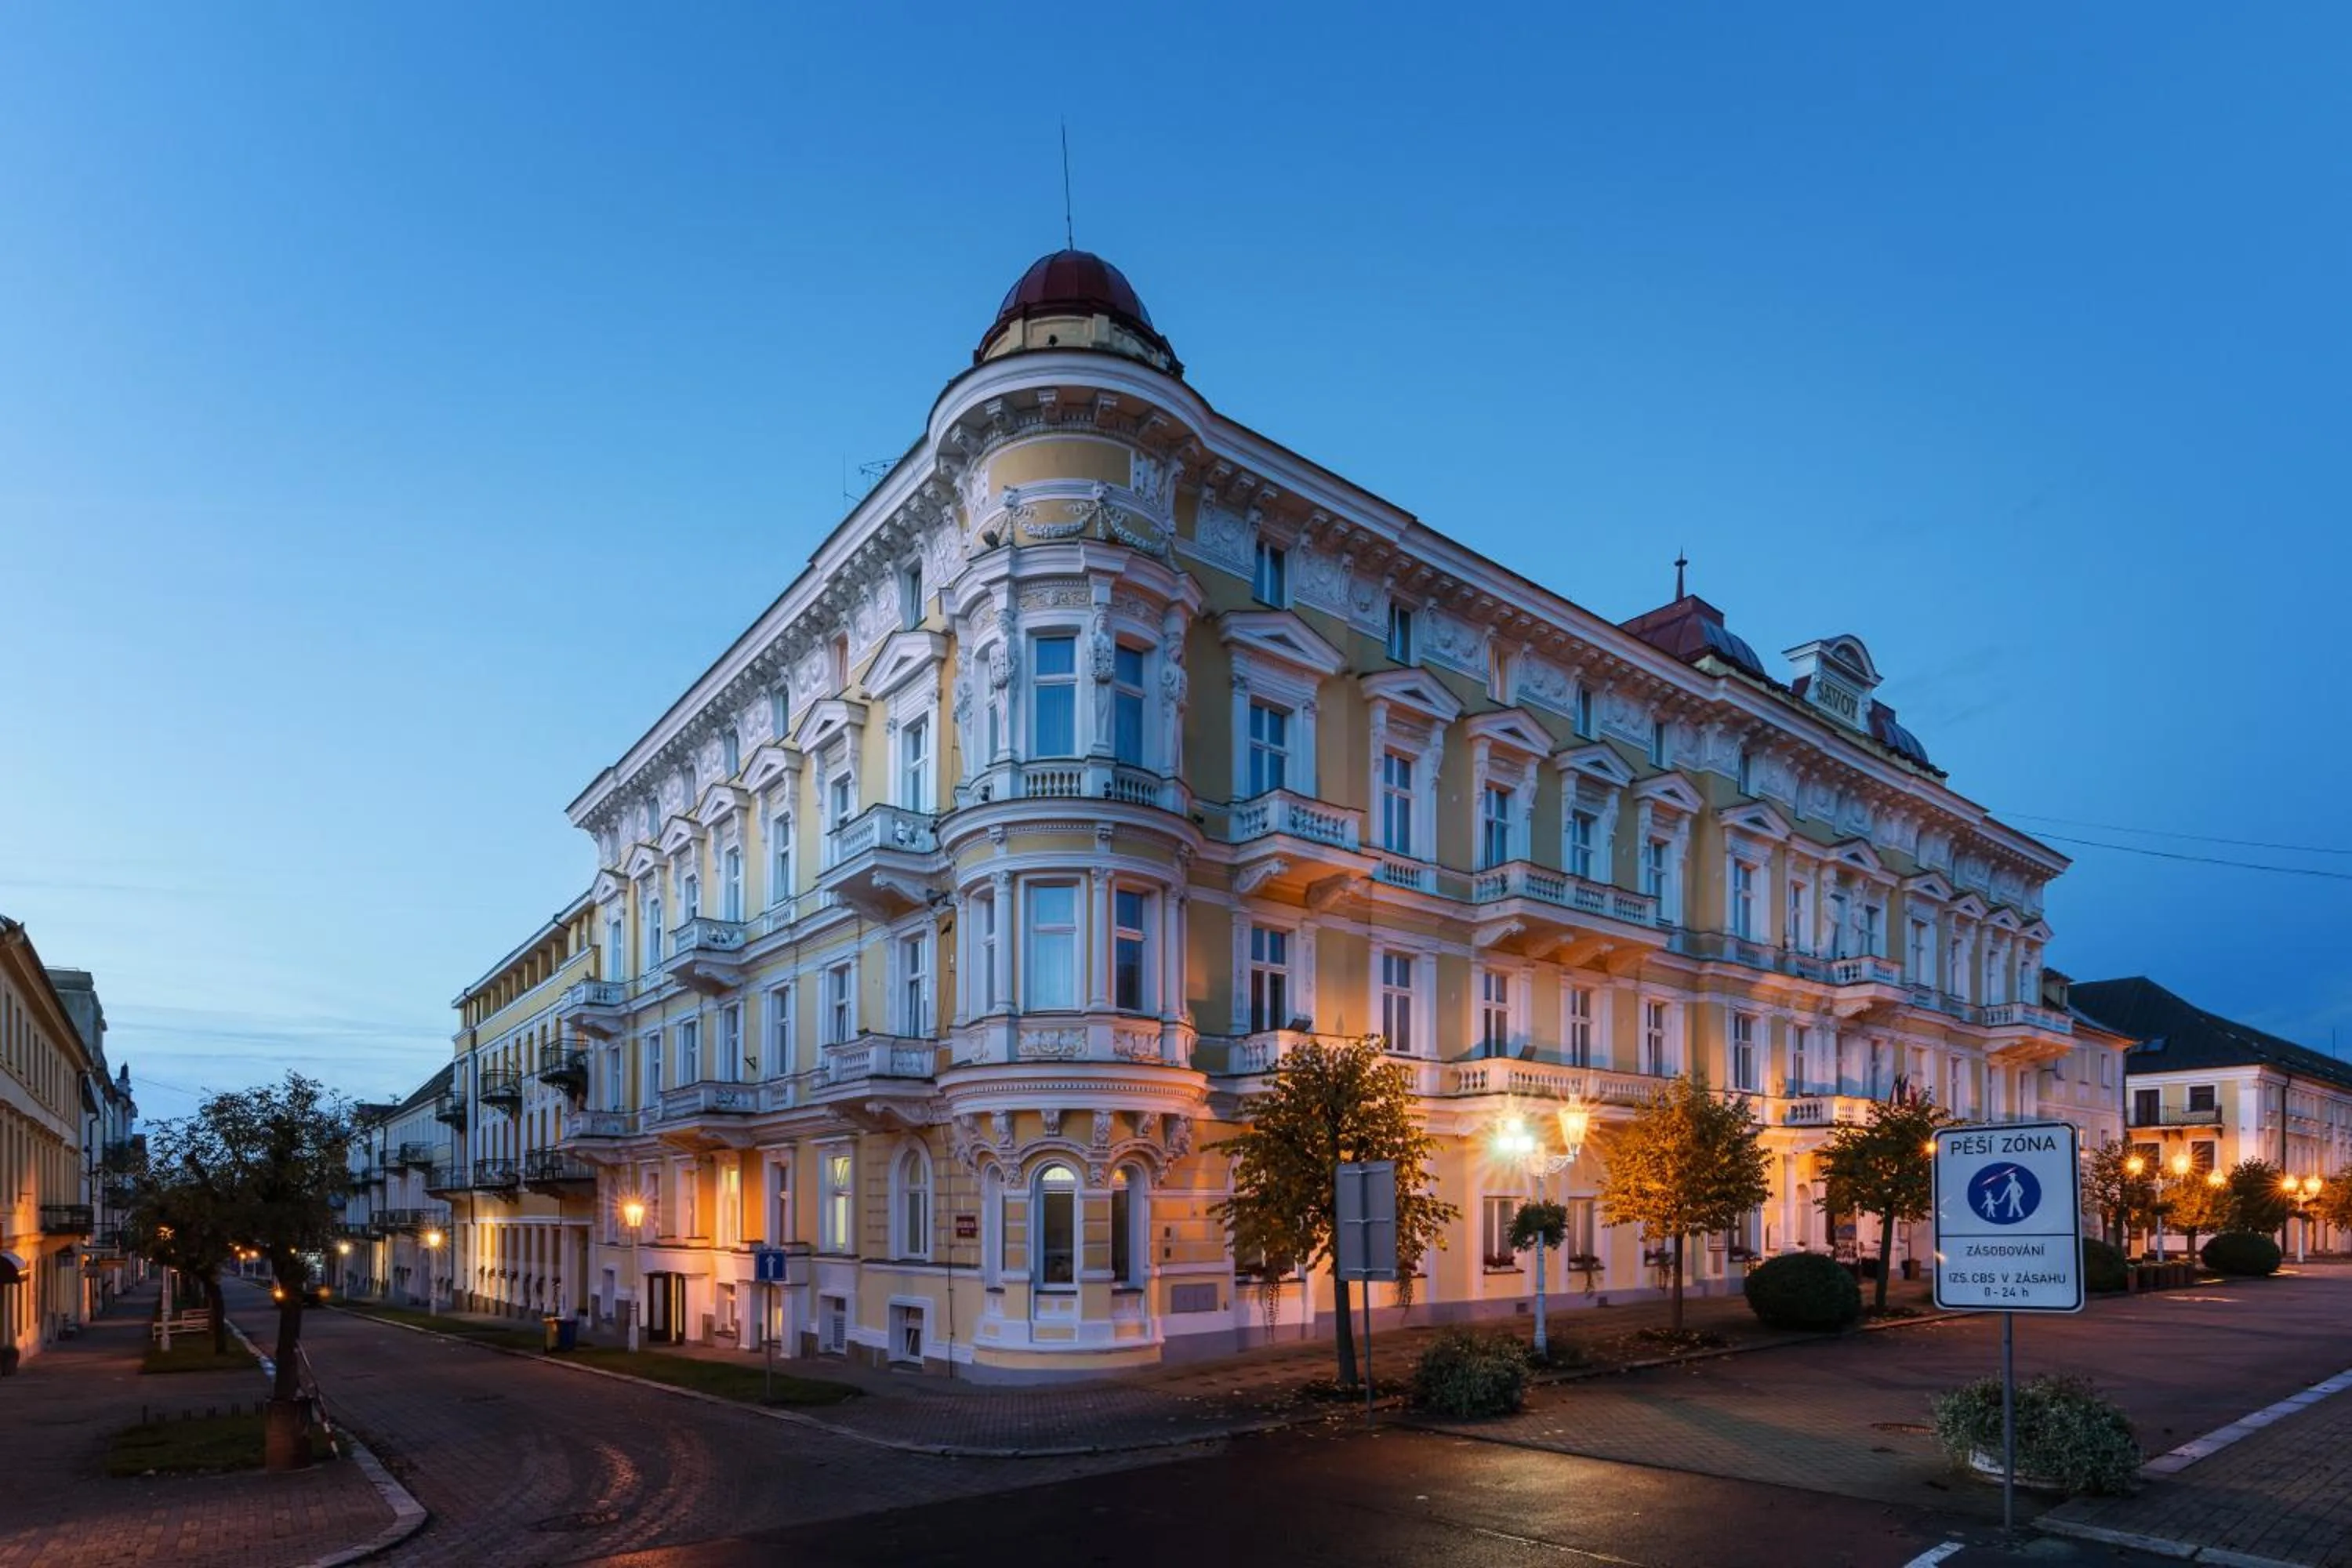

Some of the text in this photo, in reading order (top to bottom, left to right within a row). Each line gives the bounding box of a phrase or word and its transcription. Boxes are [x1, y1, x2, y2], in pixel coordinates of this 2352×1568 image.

[1817, 682, 1858, 719] SAVOY
[1951, 1134, 2056, 1155] PĚŠÍ ZÓNA
[1966, 1243, 2045, 1256] ZÁSOBOVÁNÍ
[2001, 1272, 2009, 1283] V
[2015, 1269, 2067, 1283] ZÁSAHU
[2002, 1287, 2016, 1298] 24
[2021, 1287, 2030, 1298] h
